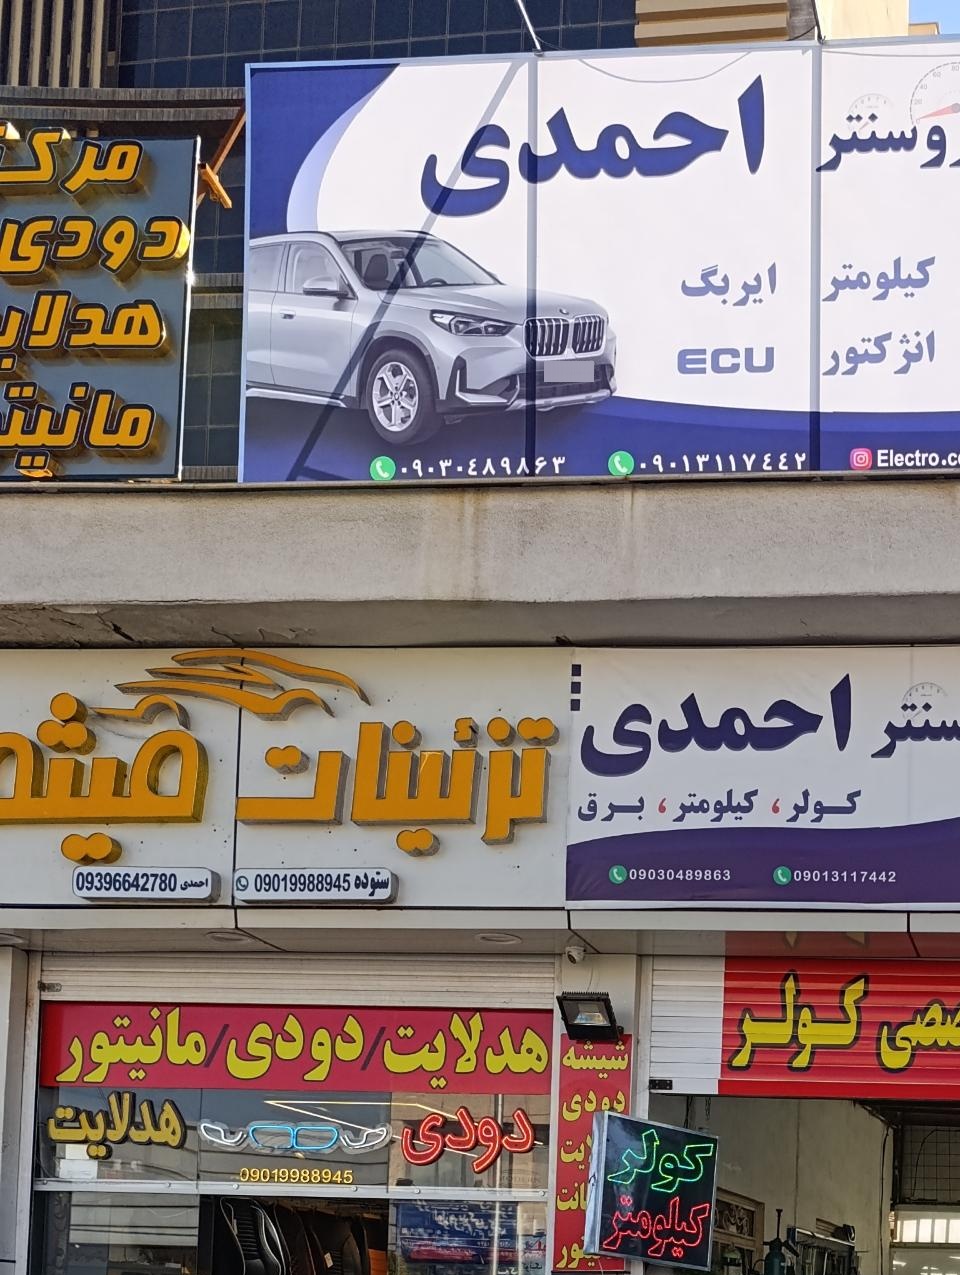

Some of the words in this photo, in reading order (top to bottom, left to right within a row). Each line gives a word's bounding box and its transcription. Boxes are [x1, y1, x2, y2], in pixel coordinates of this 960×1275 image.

[0, 122, 142, 194] مرک
[420, 74, 765, 217] احمدی
[681, 262, 777, 306] ایربگ
[822, 256, 936, 302] کیلومتر
[677, 347, 775, 375] ECU
[822, 330, 936, 376] انژکتور
[581, 674, 852, 776] احمدی
[577, 793, 645, 822] برق
[76, 872, 178, 893] 09396642780
[180, 876, 209, 891] احمدی
[254, 873, 350, 893] 09019988945
[629, 868, 731, 881] 09030489863
[793, 869, 896, 882] 09013117442
[729, 971, 868, 1070] کولر
[562, 1041, 629, 1079] شیشه
[47, 1090, 185, 1160] هدلایت
[401, 1106, 535, 1173] دودی
[240, 1167, 353, 1184] 09019988945
[607, 1129, 713, 1193] کولر
[602, 1195, 710, 1257] کیلومتر
